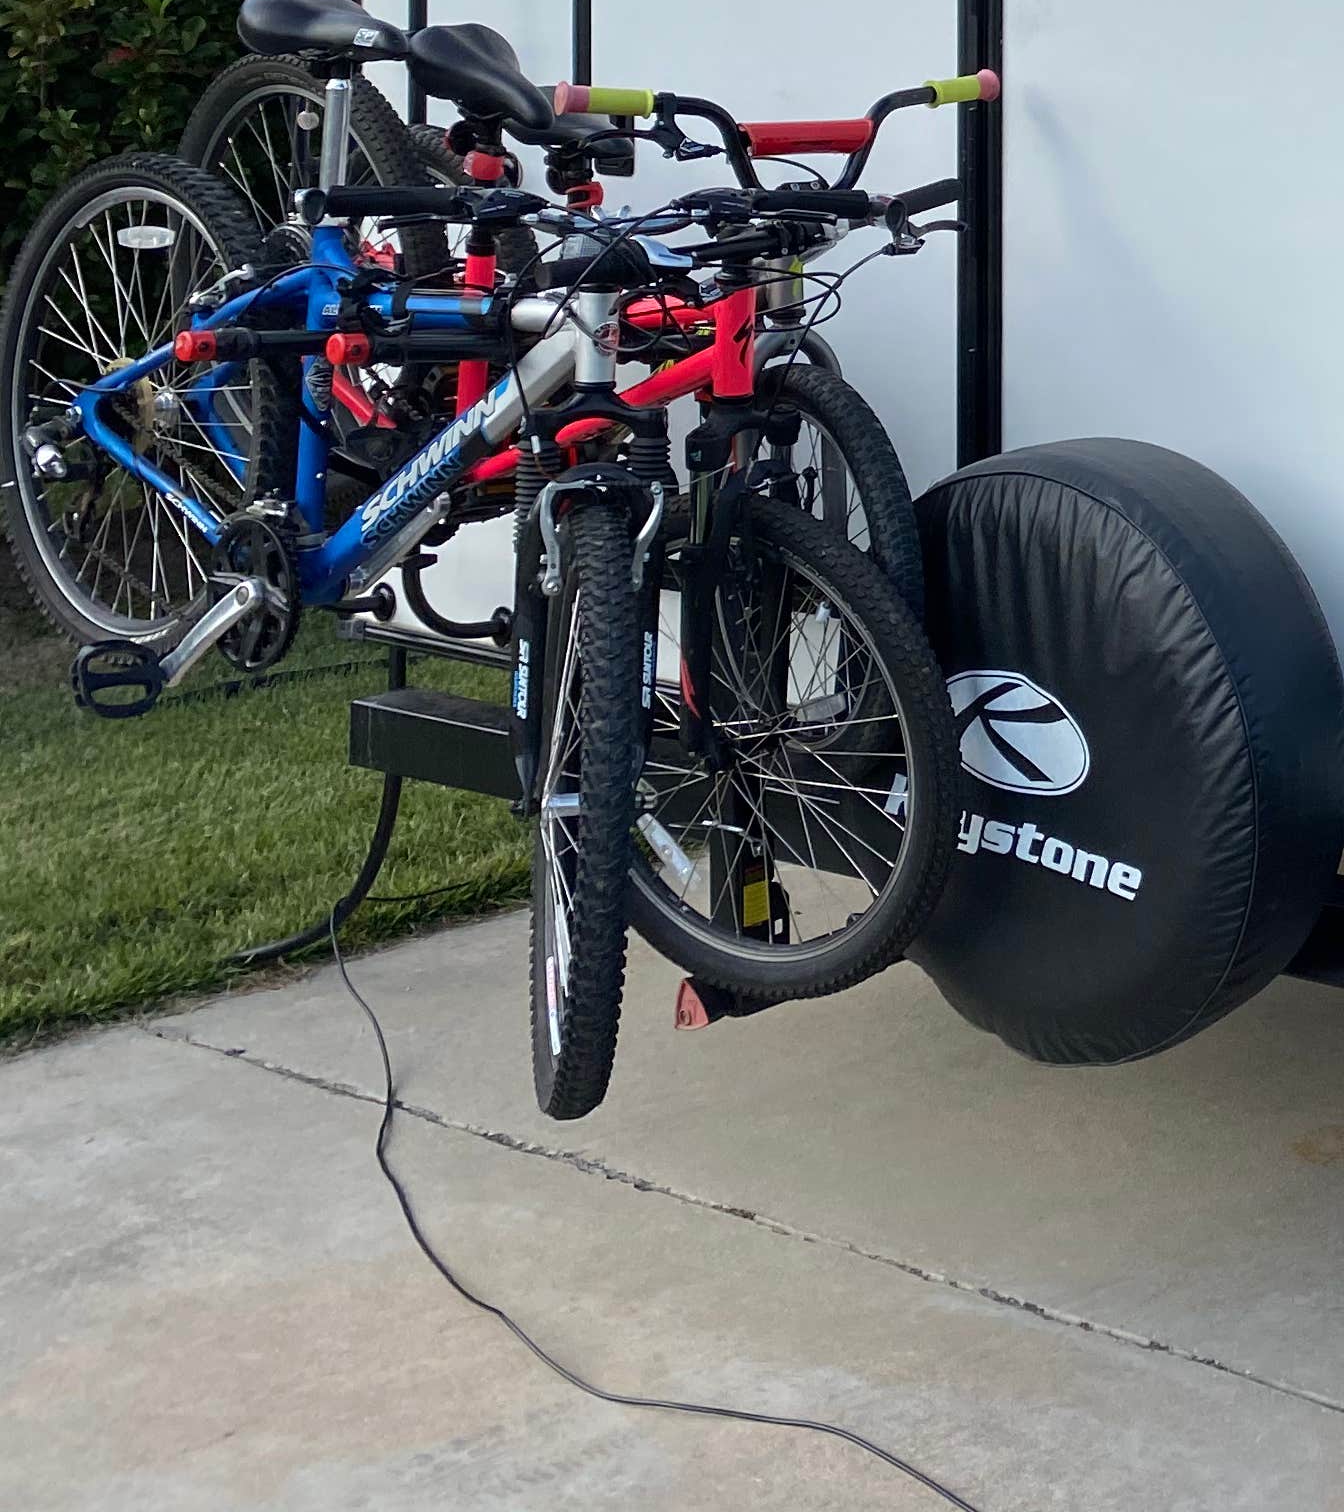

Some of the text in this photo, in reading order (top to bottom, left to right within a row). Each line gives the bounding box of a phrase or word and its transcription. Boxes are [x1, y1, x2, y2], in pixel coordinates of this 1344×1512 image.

[361, 387, 497, 532] SCHWINN
[517, 663, 529, 719] SUNTOUR
[884, 772, 1143, 901] ystone
